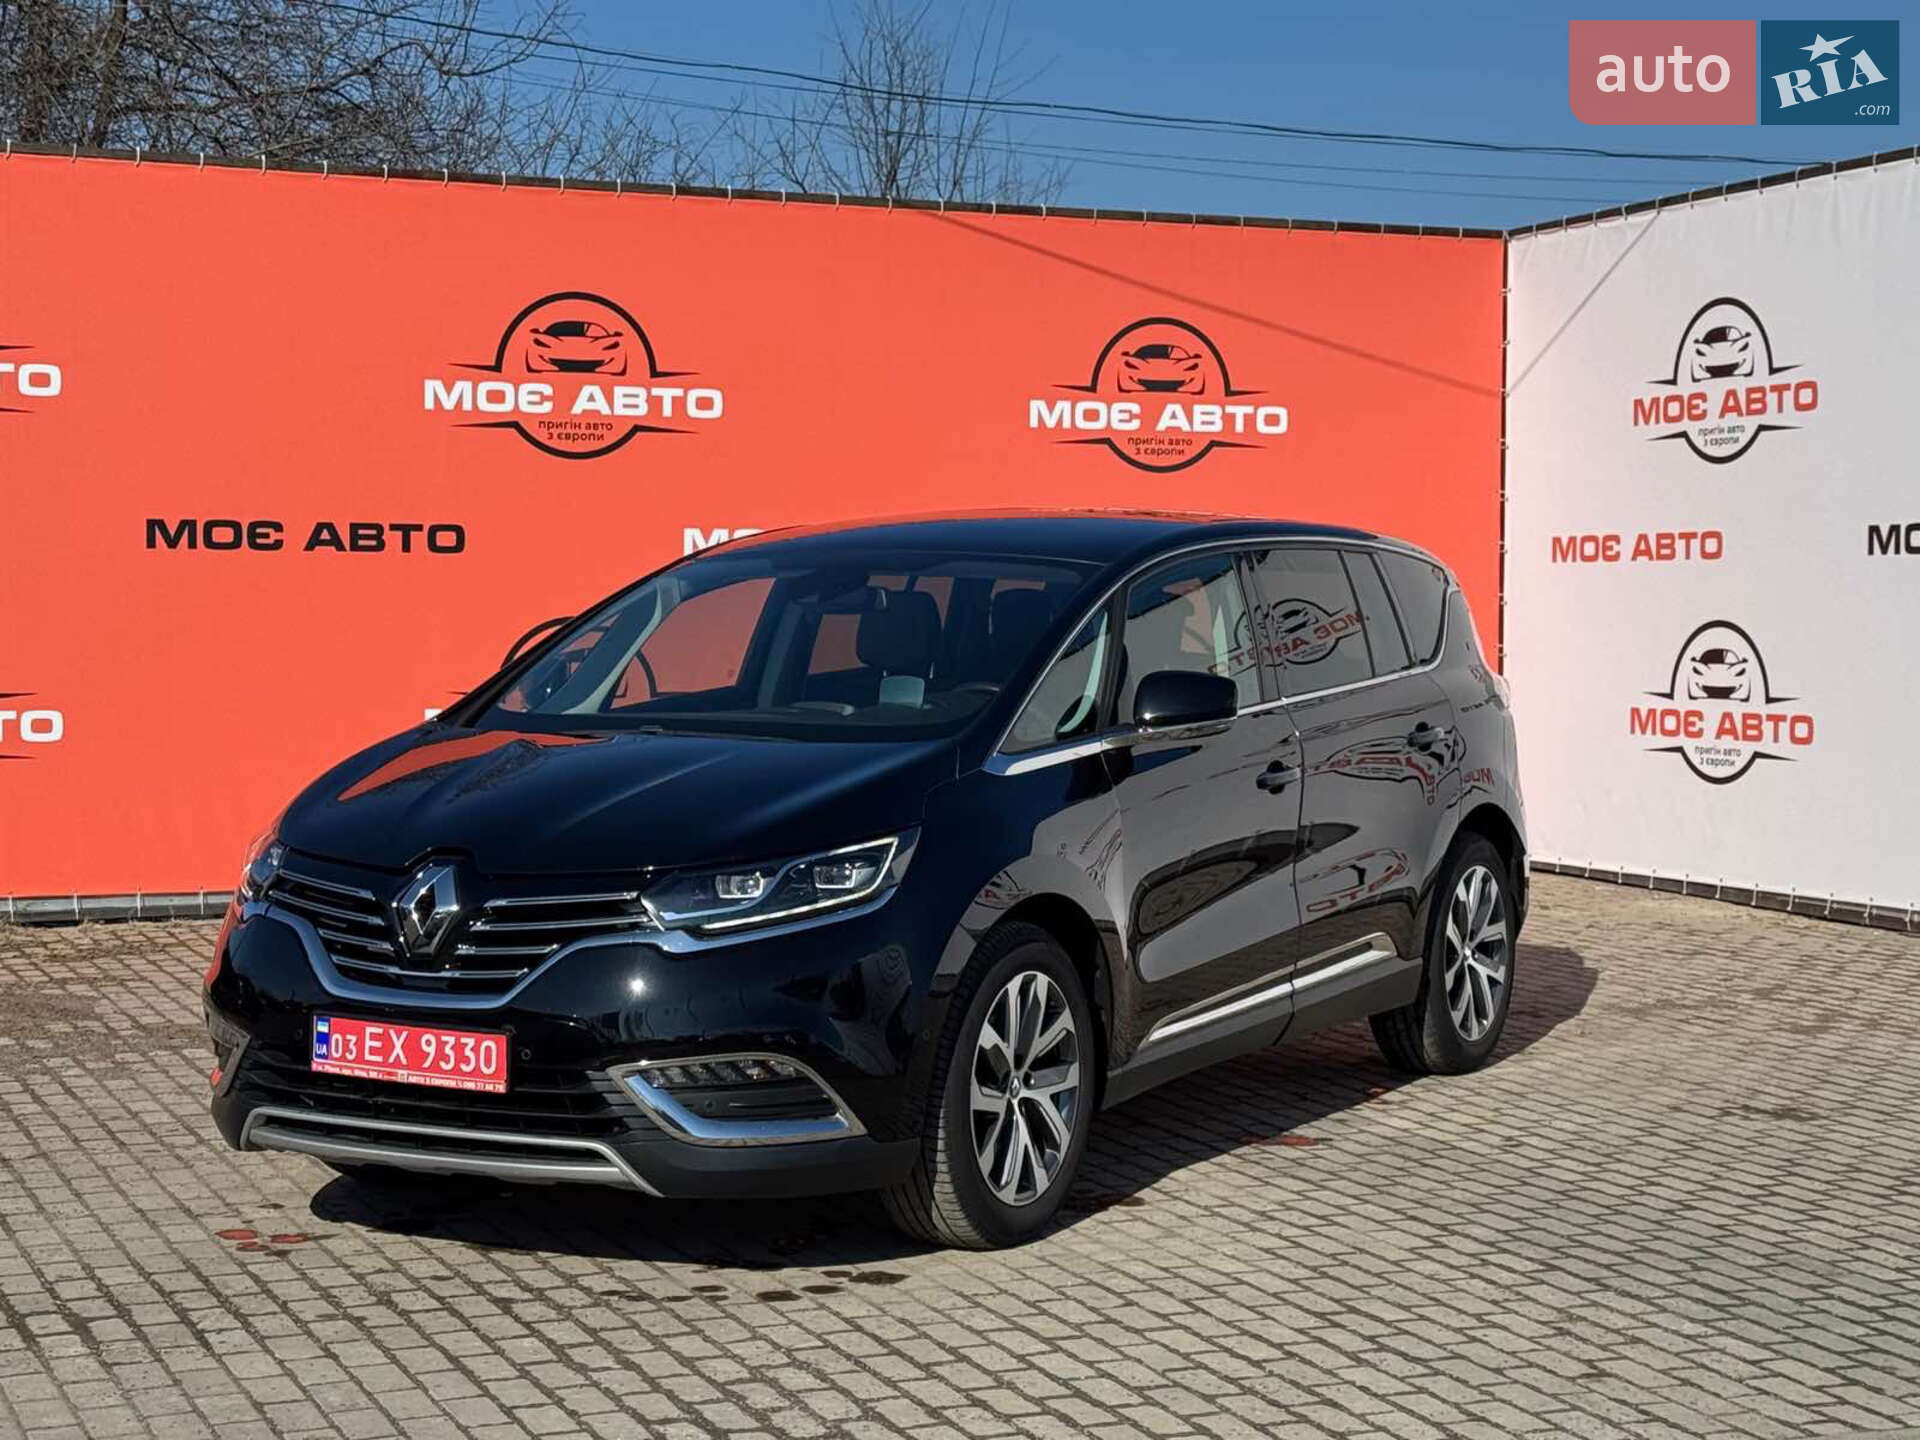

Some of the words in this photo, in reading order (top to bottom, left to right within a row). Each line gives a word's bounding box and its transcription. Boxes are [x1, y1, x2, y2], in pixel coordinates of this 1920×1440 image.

[424, 379, 553, 414] МОЄ
[571, 384, 723, 419] АВТО
[1632, 392, 1708, 426] МОЄ
[1718, 380, 1819, 419] АВТО
[538, 419, 581, 431] пригін
[584, 421, 613, 431] авто
[1029, 399, 1141, 431] МОЄ
[1156, 403, 1288, 435] АВТО
[546, 432, 554, 440] з
[557, 432, 604, 443] європи
[1168, 438, 1193, 446] авто
[146, 518, 284, 552] МОЄ
[303, 522, 466, 554] АВТО
[683, 527, 765, 557] М
[1551, 534, 1621, 564] МОЄ
[1631, 530, 1724, 562] АВТО
[1629, 707, 1705, 740] МОЄ
[1714, 711, 1815, 747] АВТО
[316, 1042, 329, 1056] UA
[331, 1033, 357, 1061] 03
[364, 1026, 409, 1066] EX
[420, 1033, 498, 1076] 9330
